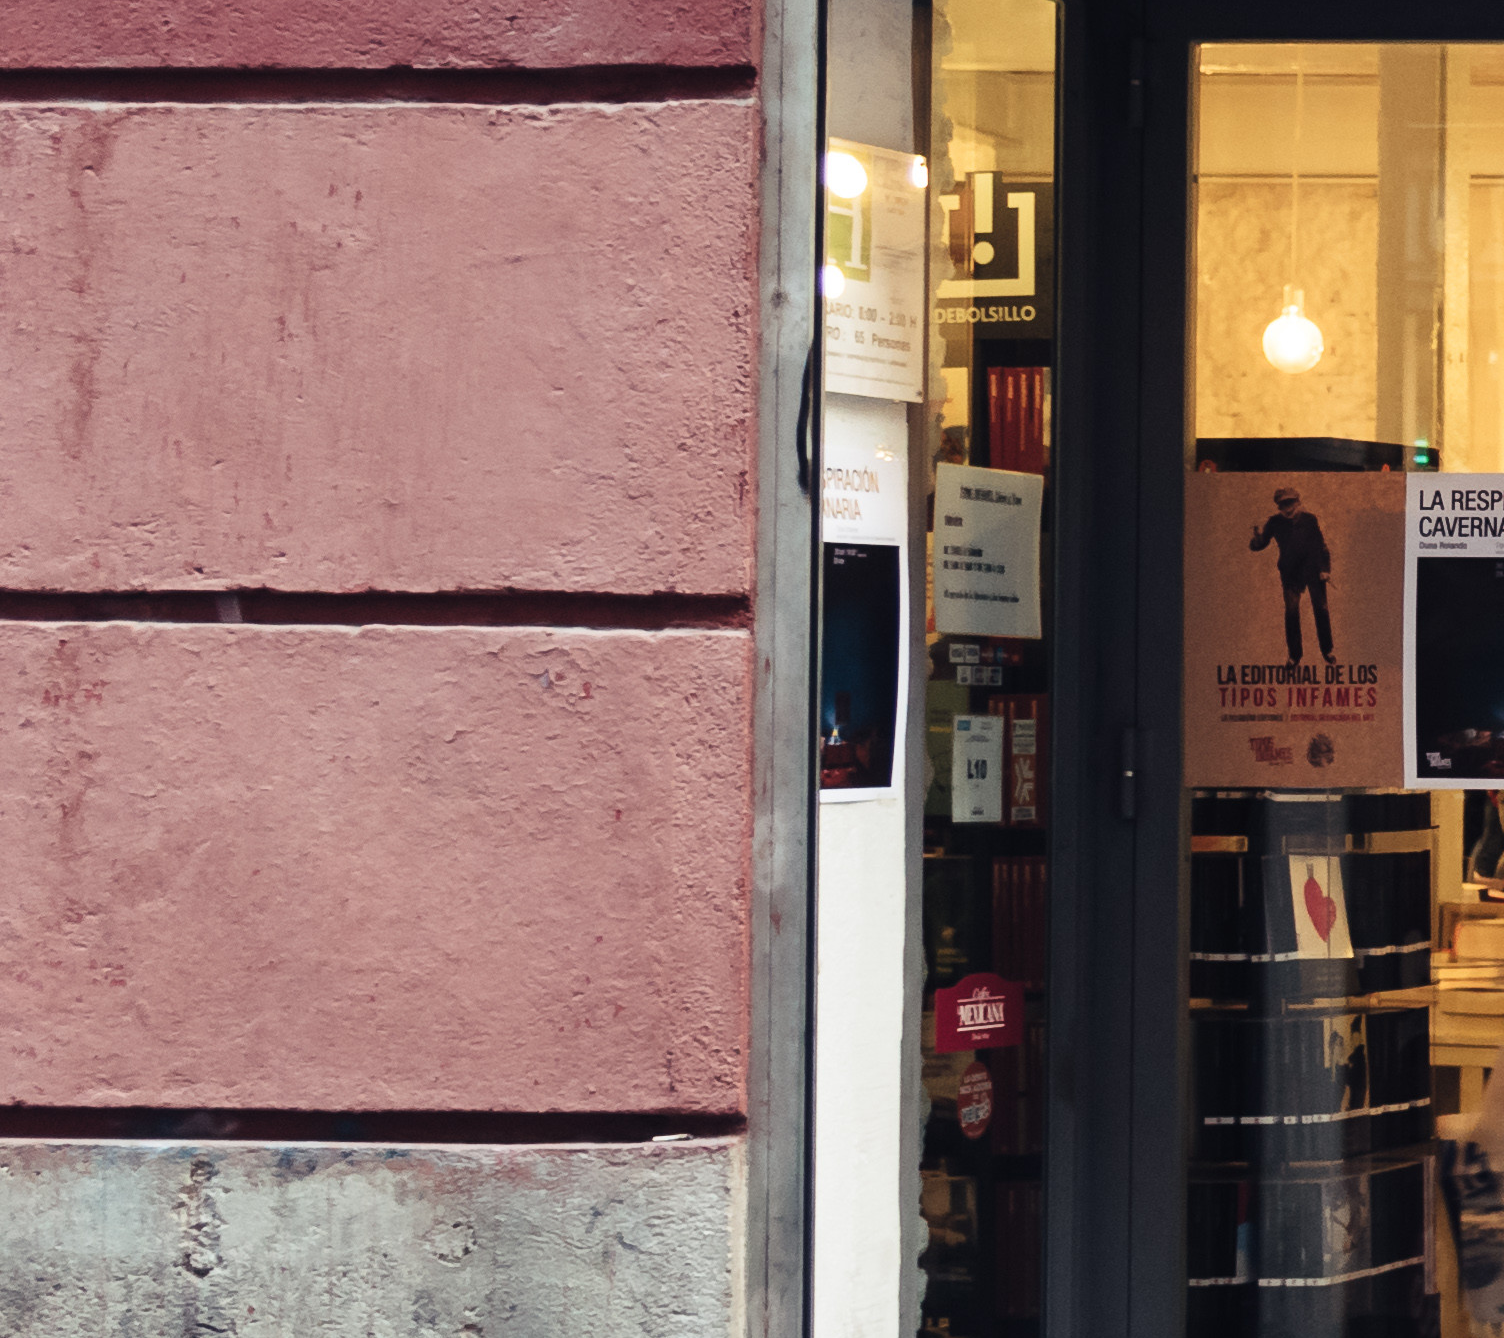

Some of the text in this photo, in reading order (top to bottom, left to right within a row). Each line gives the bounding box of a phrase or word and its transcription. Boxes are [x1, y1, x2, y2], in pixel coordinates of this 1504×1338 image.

[1419, 489, 1445, 511] LA
[1217, 664, 1378, 685] LA EDITORIAL DE LOS
[1219, 687, 1377, 708] TIPOS INFAMES
